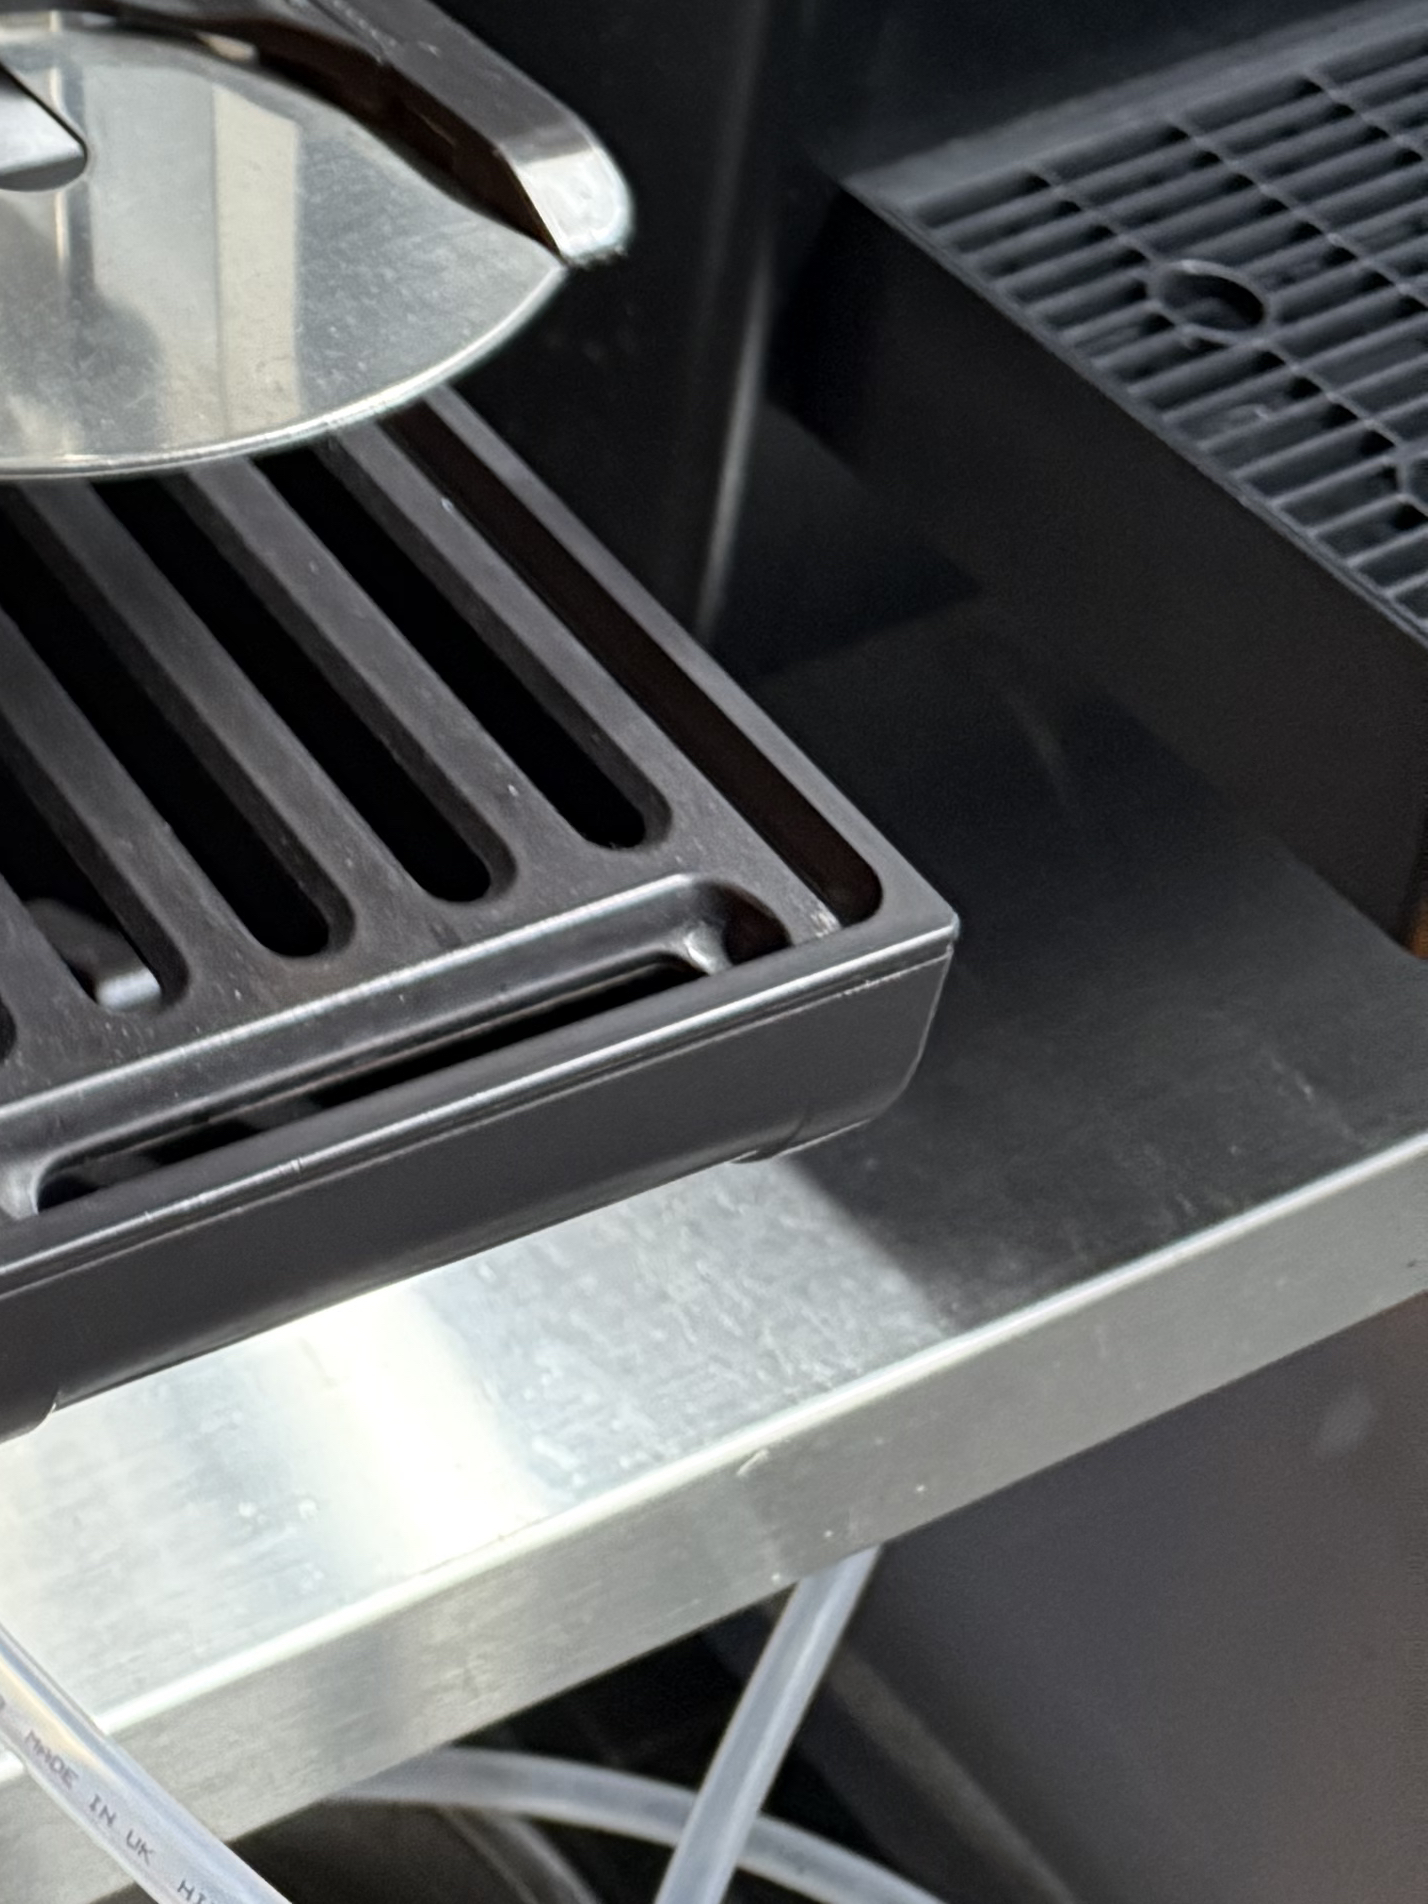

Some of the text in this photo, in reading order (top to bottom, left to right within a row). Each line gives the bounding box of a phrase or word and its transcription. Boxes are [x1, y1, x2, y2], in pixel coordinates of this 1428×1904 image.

[25, 1729, 79, 1791] MADE
[88, 1794, 117, 1828] IN
[126, 1831, 154, 1865] UK
